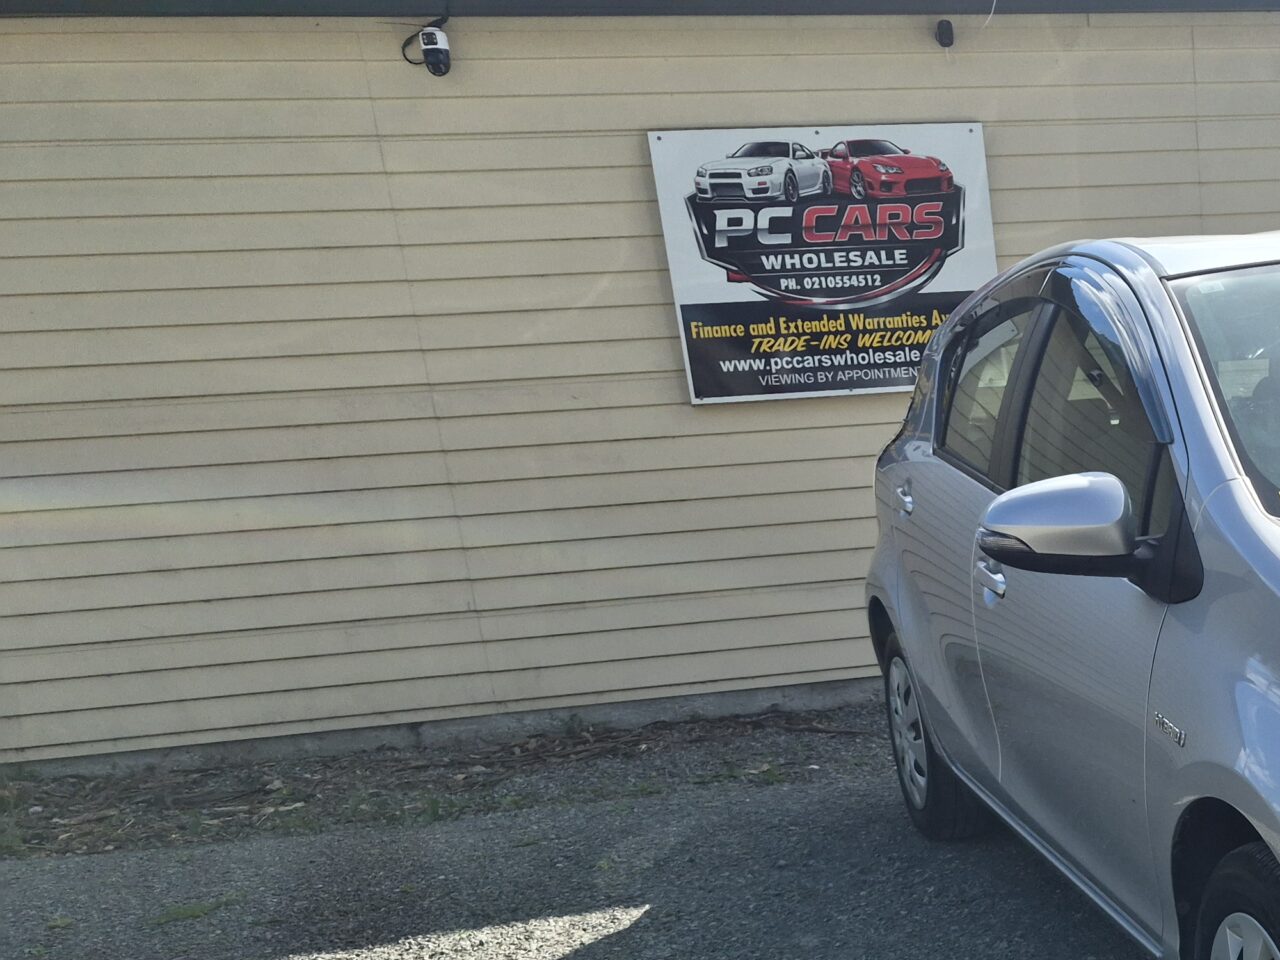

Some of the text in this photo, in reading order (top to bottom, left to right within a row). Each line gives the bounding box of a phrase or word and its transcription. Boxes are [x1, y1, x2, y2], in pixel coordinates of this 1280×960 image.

[713, 202, 945, 248] PC CARS
[760, 250, 908, 270] WHOLESALE
[780, 274, 882, 290] PH. 0210554512
[690, 321, 745, 339] Finance
[750, 317, 776, 336] and
[779, 313, 846, 334] Extended
[849, 311, 927, 331] Warranties
[750, 334, 852, 354] TRADE-INS
[758, 366, 922, 386] VIEWING BY APPOINTMEN
